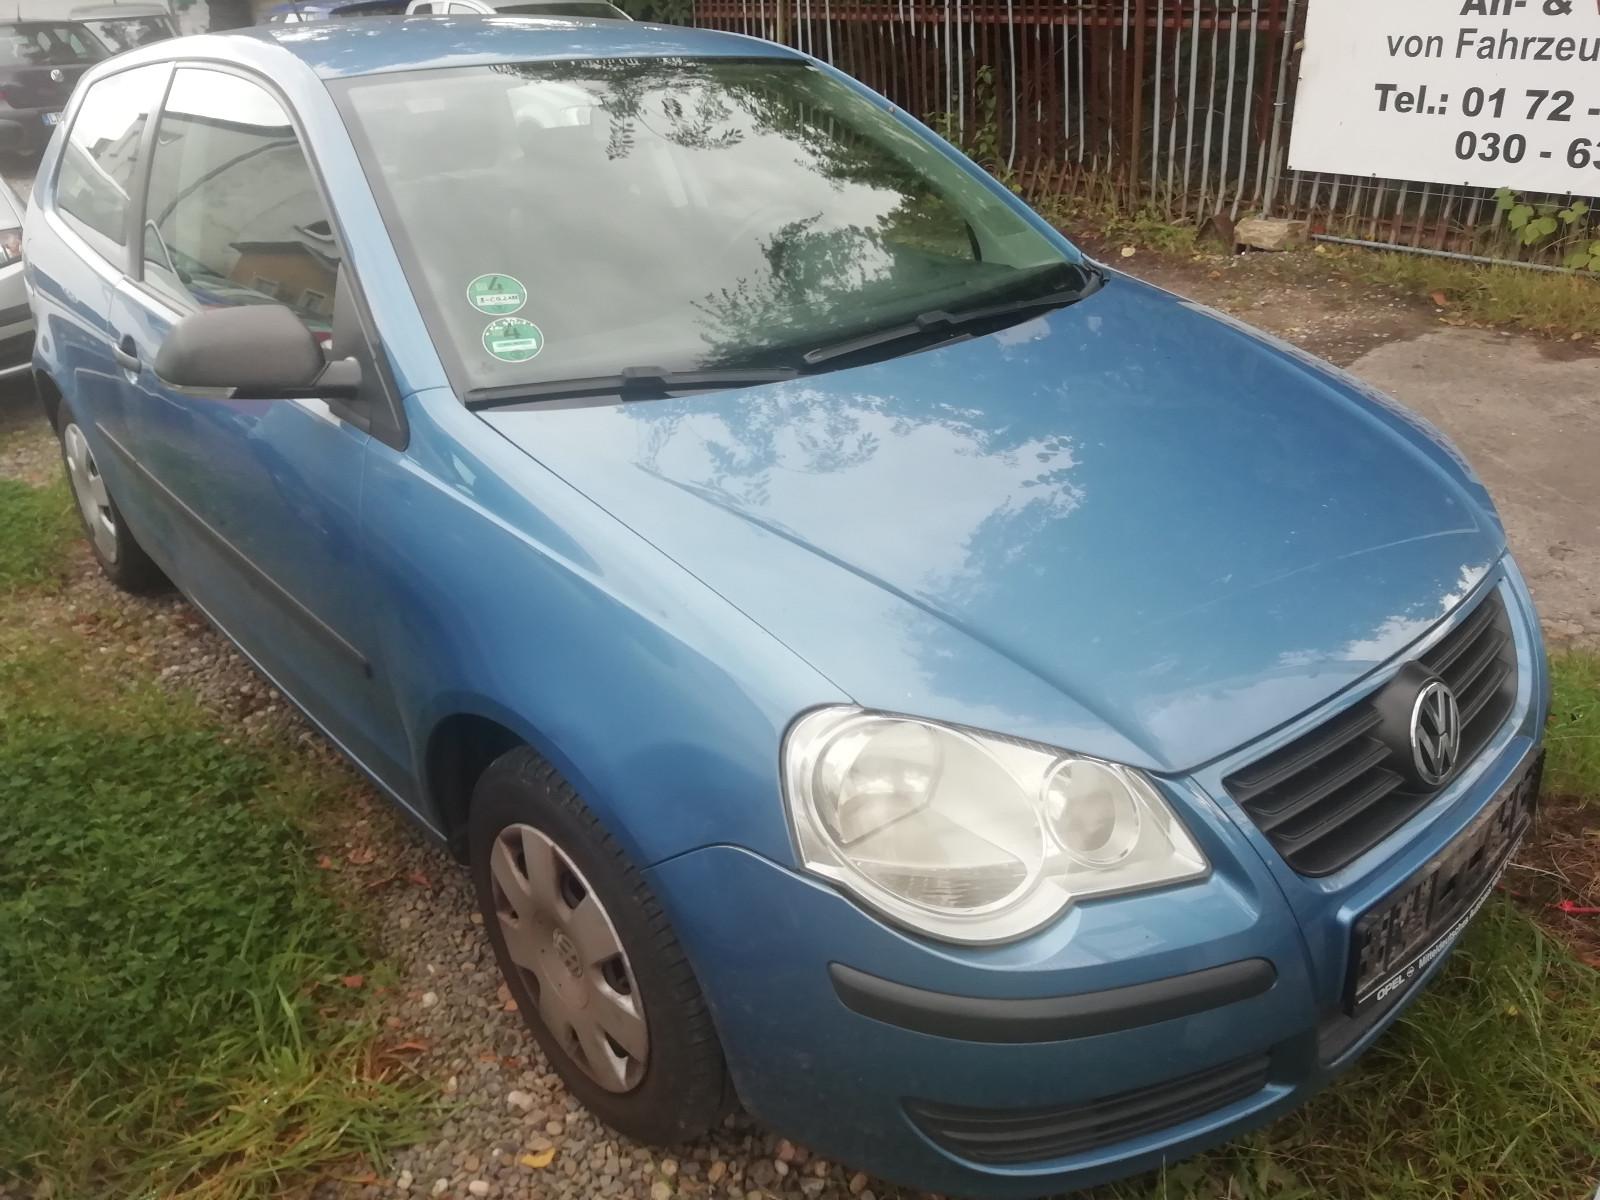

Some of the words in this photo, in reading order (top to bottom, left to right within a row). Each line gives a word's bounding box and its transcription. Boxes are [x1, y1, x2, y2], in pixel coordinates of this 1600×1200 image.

[1386, 34, 1444, 58] von
[1455, 28, 1600, 61] Fahrzeu
[1374, 83, 1449, 115] Tel.:
[1461, 86, 1507, 119] 01
[1525, 89, 1575, 122] 72
[1454, 130, 1527, 164] 030
[1376, 974, 1406, 1001] OPEL
